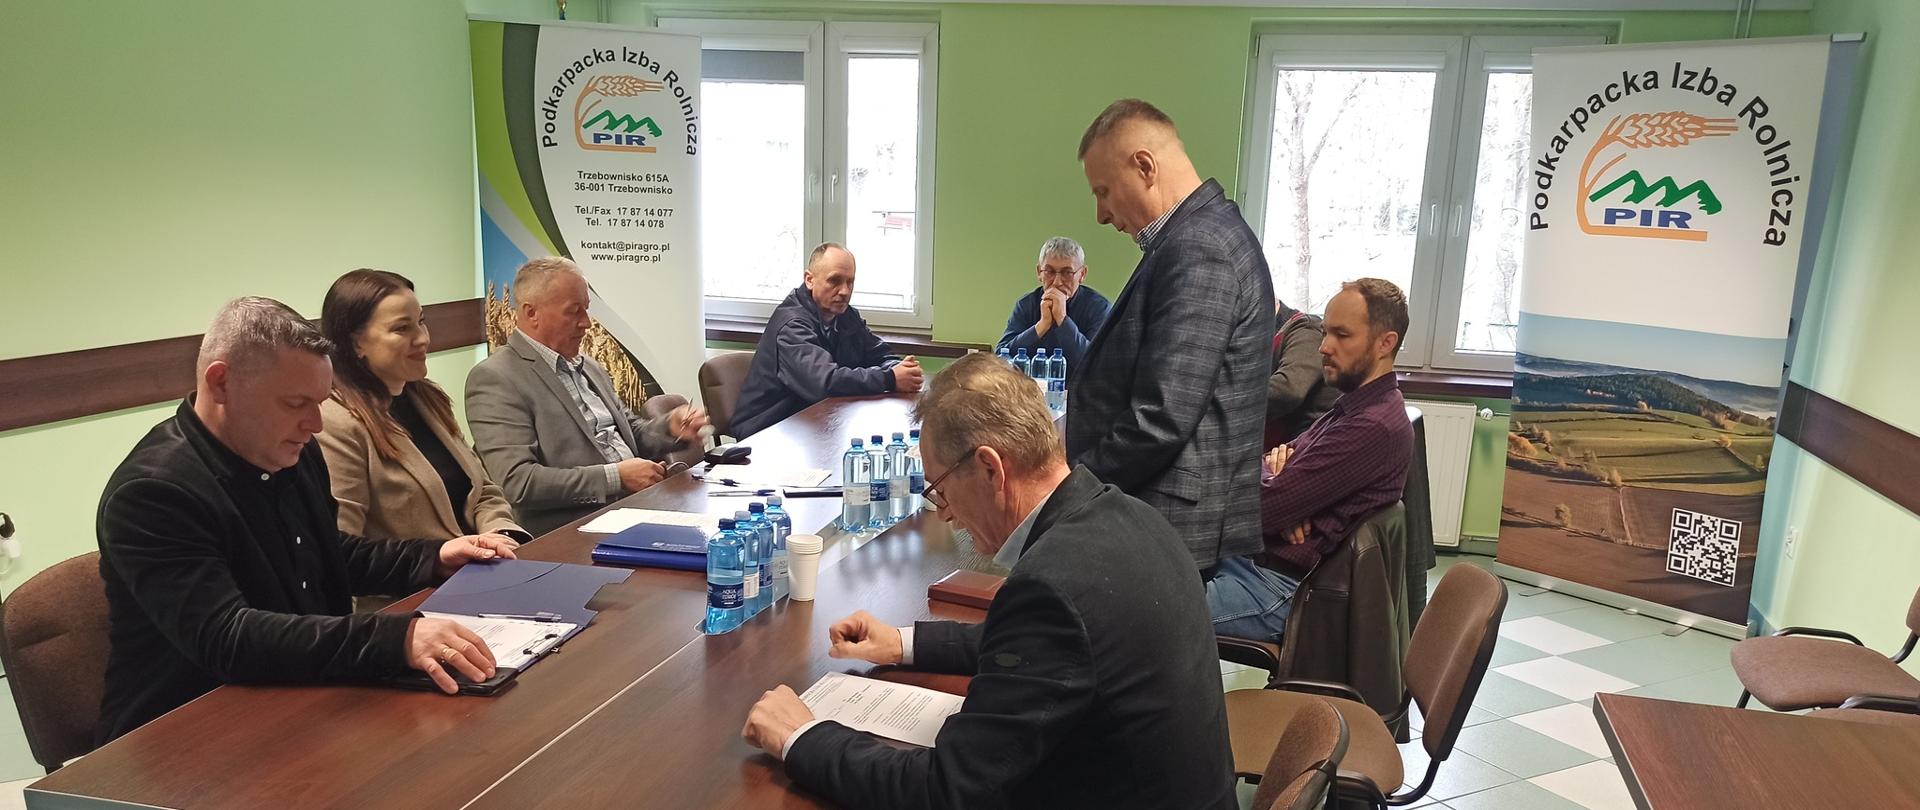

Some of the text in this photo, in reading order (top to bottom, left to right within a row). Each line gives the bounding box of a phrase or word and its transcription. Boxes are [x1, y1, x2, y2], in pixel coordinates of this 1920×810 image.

[543, 46, 698, 156] Podkarpacka Izba Rolnicza
[593, 133, 646, 146] PIR
[1530, 61, 1801, 247] Podkarpacka Izba Rolnicza
[577, 170, 669, 183] Trzebownisko 615A
[574, 182, 673, 195] 36-001 Trzebownisko
[575, 205, 673, 217] Tel./Fax 17 87 14 077
[585, 217, 664, 228] Tel. 17 87 14 078
[1603, 207, 1692, 229] PIR
[580, 240, 670, 252] kontakt@piragro.pl
[591, 253, 661, 263] www.piragro.pl
